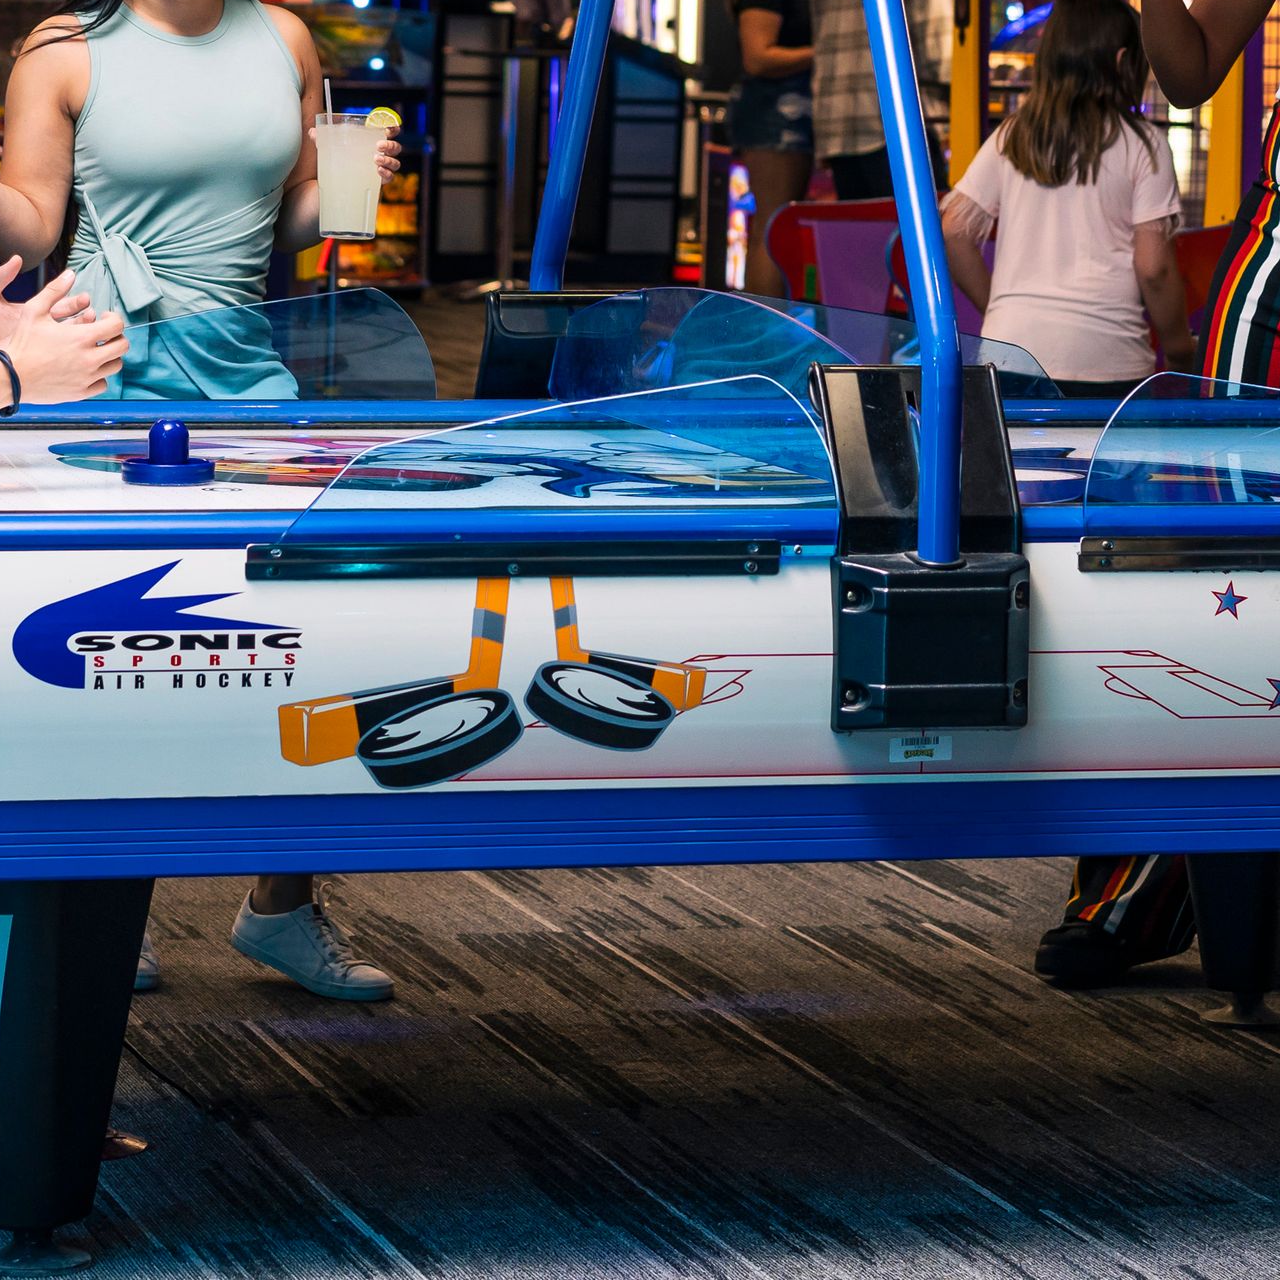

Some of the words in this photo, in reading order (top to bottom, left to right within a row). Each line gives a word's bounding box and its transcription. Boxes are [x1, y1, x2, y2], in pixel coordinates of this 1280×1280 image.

[75, 632, 303, 652] SONIC
[93, 653, 296, 668] SPORTS
[93, 674, 145, 690] AIR
[172, 672, 294, 689] HOCKEY
